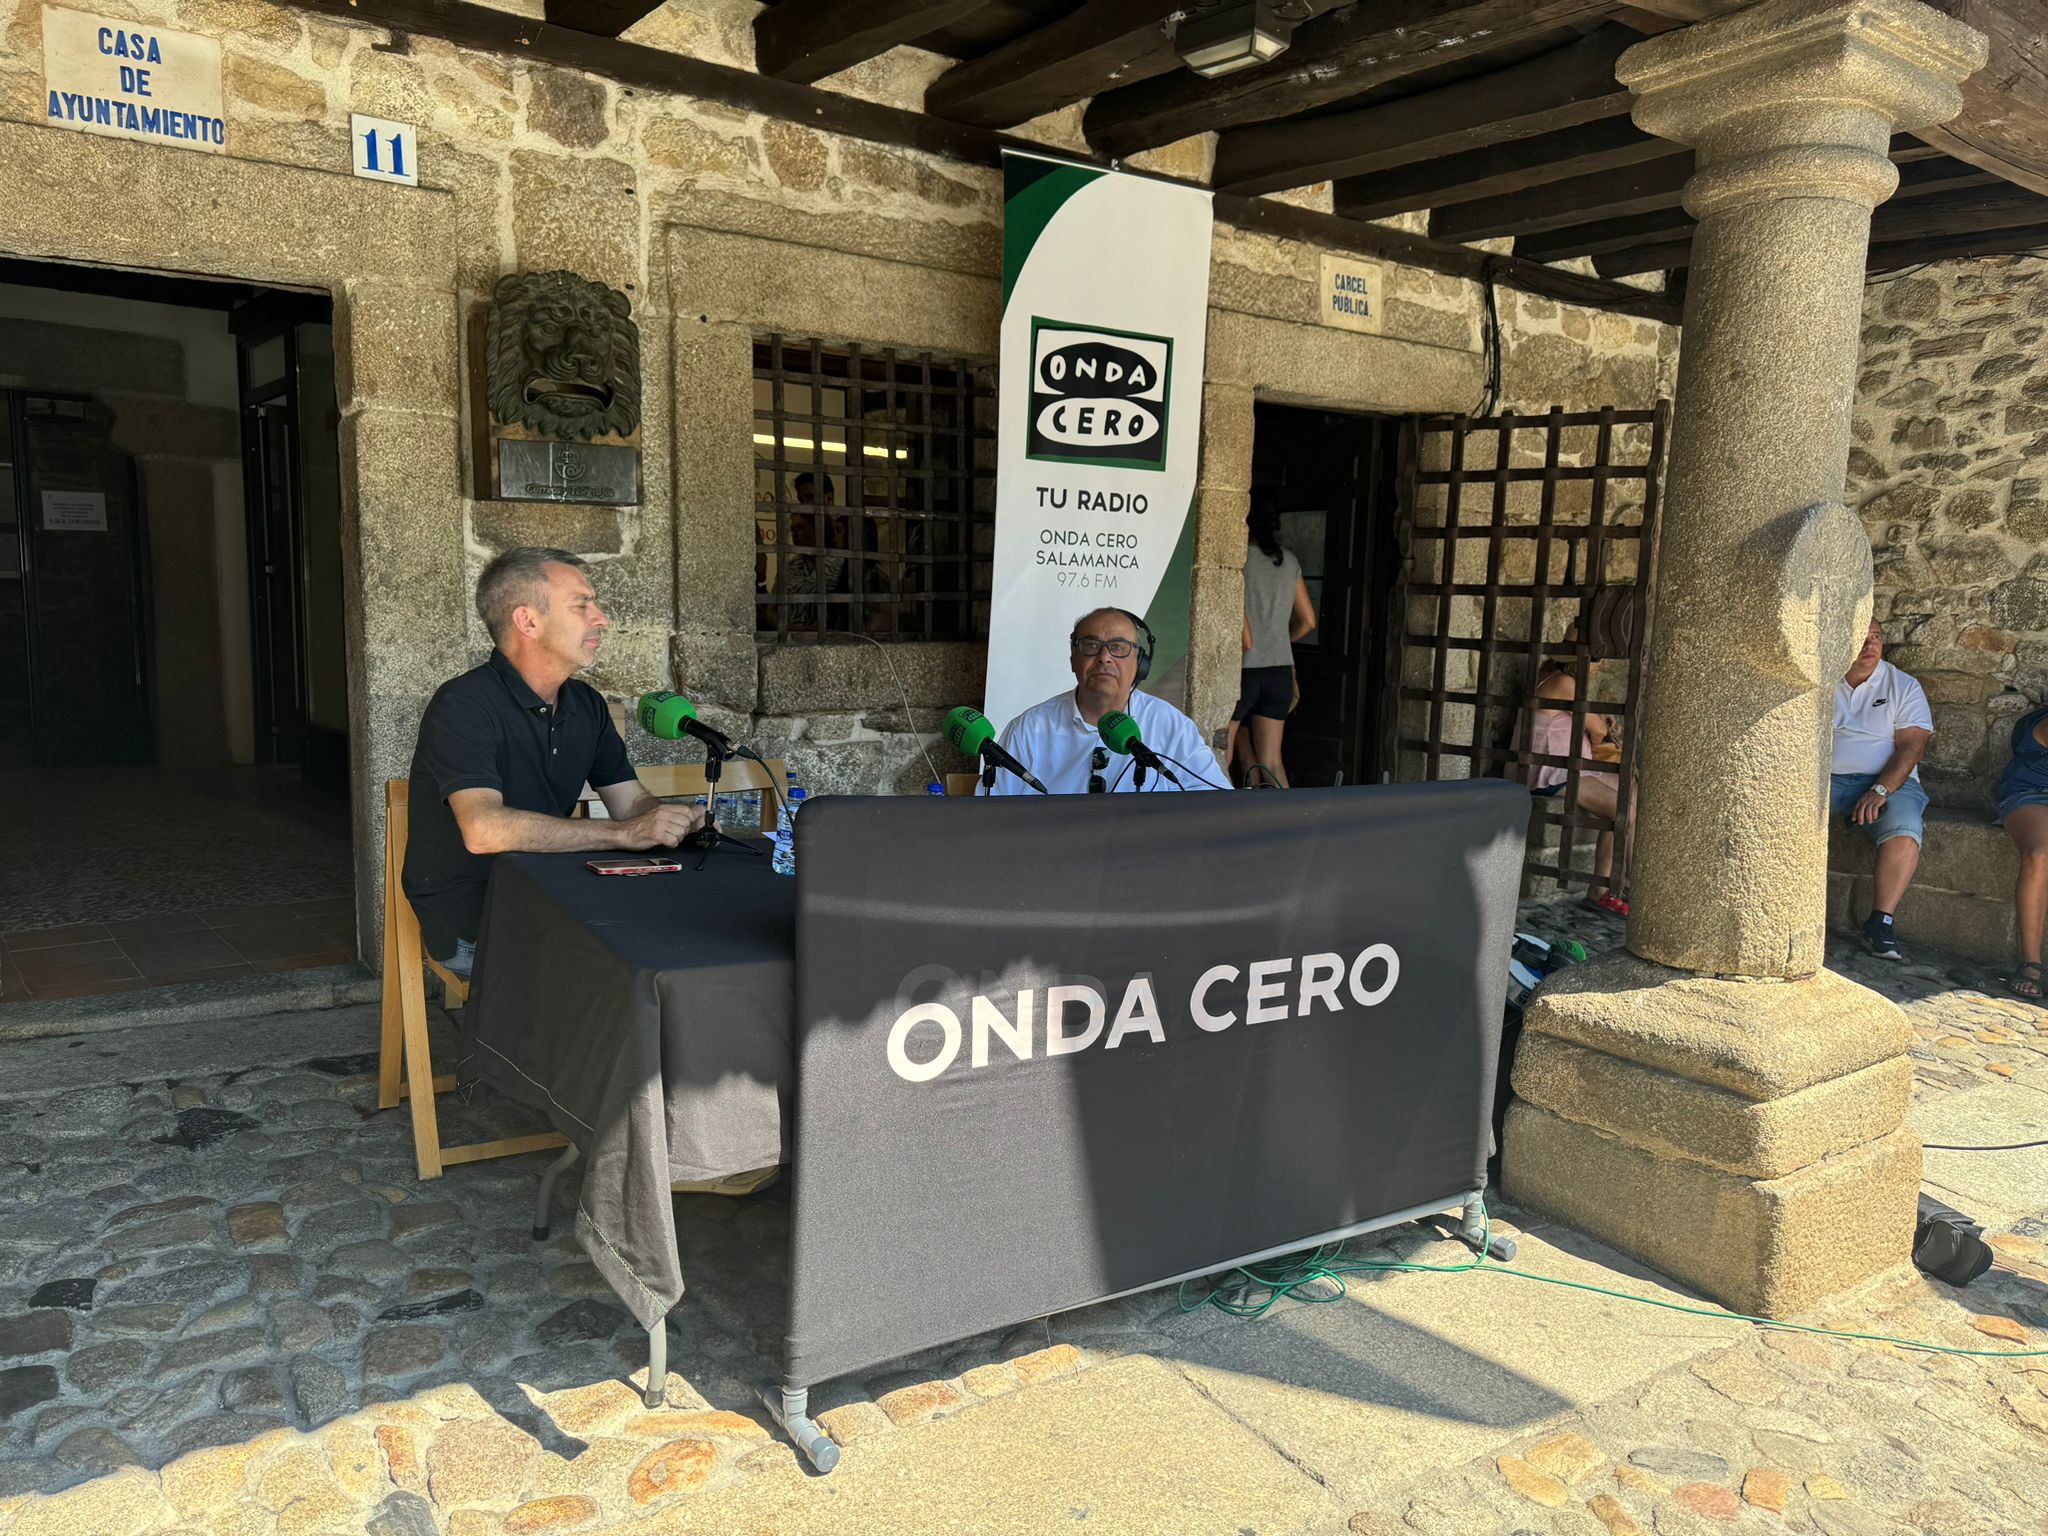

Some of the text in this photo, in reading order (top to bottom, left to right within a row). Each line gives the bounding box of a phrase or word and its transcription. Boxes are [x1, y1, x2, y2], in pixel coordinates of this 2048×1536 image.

[98, 27, 162, 64] CASA
[120, 66, 152, 96] DE
[48, 90, 225, 145] AYUNTAMIENTO
[359, 128, 410, 177] 11
[1335, 273, 1368, 294] CARCEL
[1050, 354, 1147, 387] ONDA
[1052, 405, 1145, 438] CERO
[527, 484, 561, 496] Correos
[1036, 487, 1148, 514] TU RADIO
[1040, 529, 1138, 549] ONDA CERO
[1036, 551, 1139, 570] SALAMANCA
[1057, 572, 1117, 588] 97.6 FM
[887, 943, 1400, 1082] ONDA CERO
